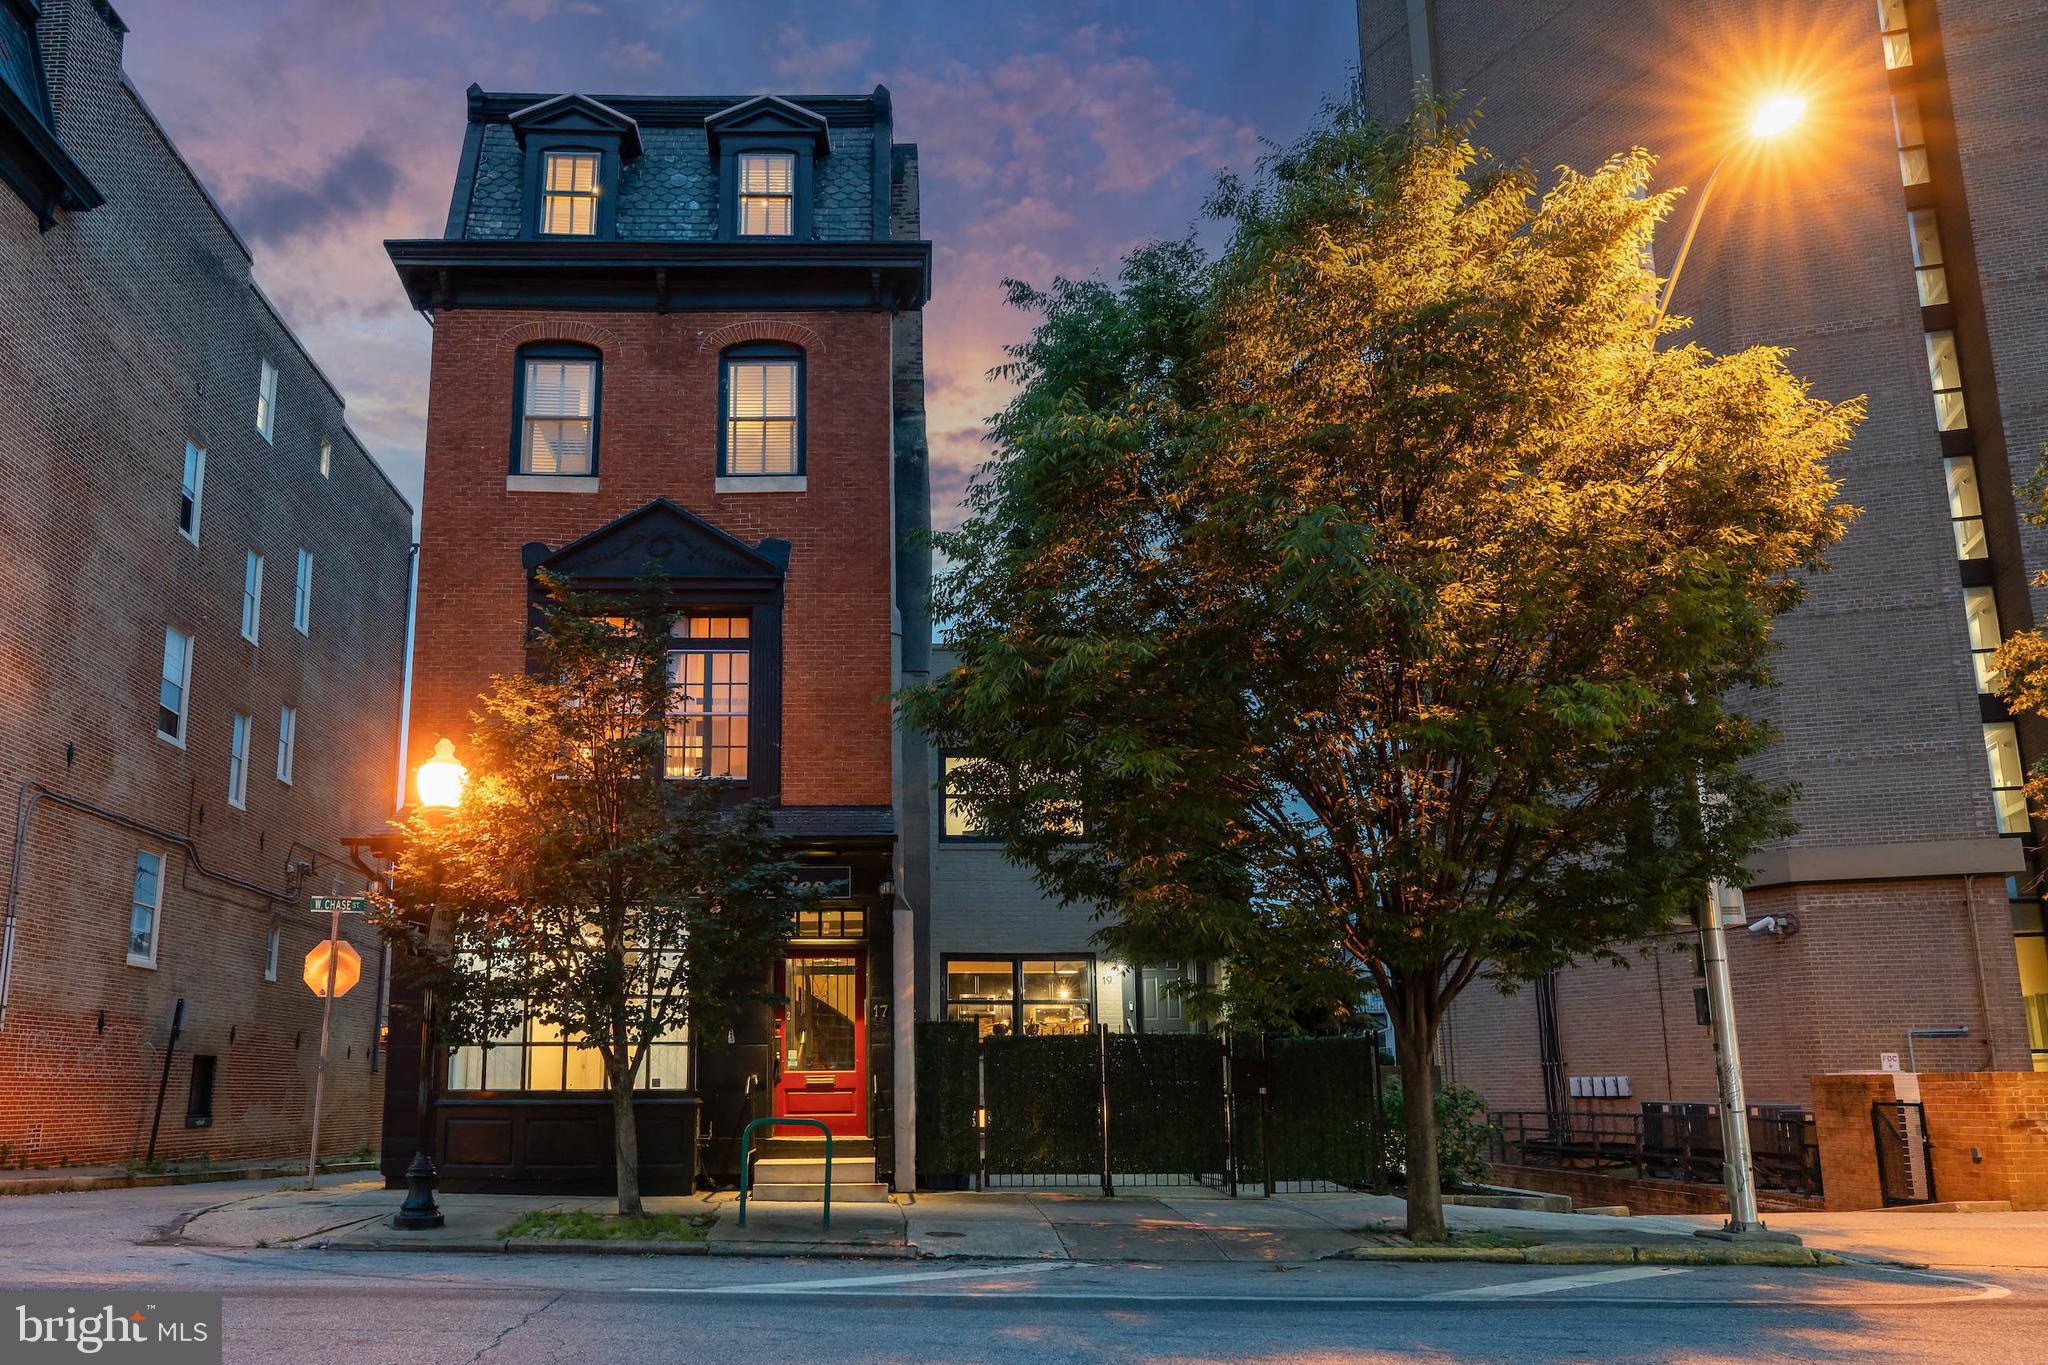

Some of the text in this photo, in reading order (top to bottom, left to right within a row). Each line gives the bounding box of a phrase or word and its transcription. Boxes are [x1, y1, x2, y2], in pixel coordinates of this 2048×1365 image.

[315, 900, 323, 910] W.
[325, 900, 351, 911] CHASE
[1103, 976, 1112, 984] 19
[873, 1004, 888, 1017] 17
